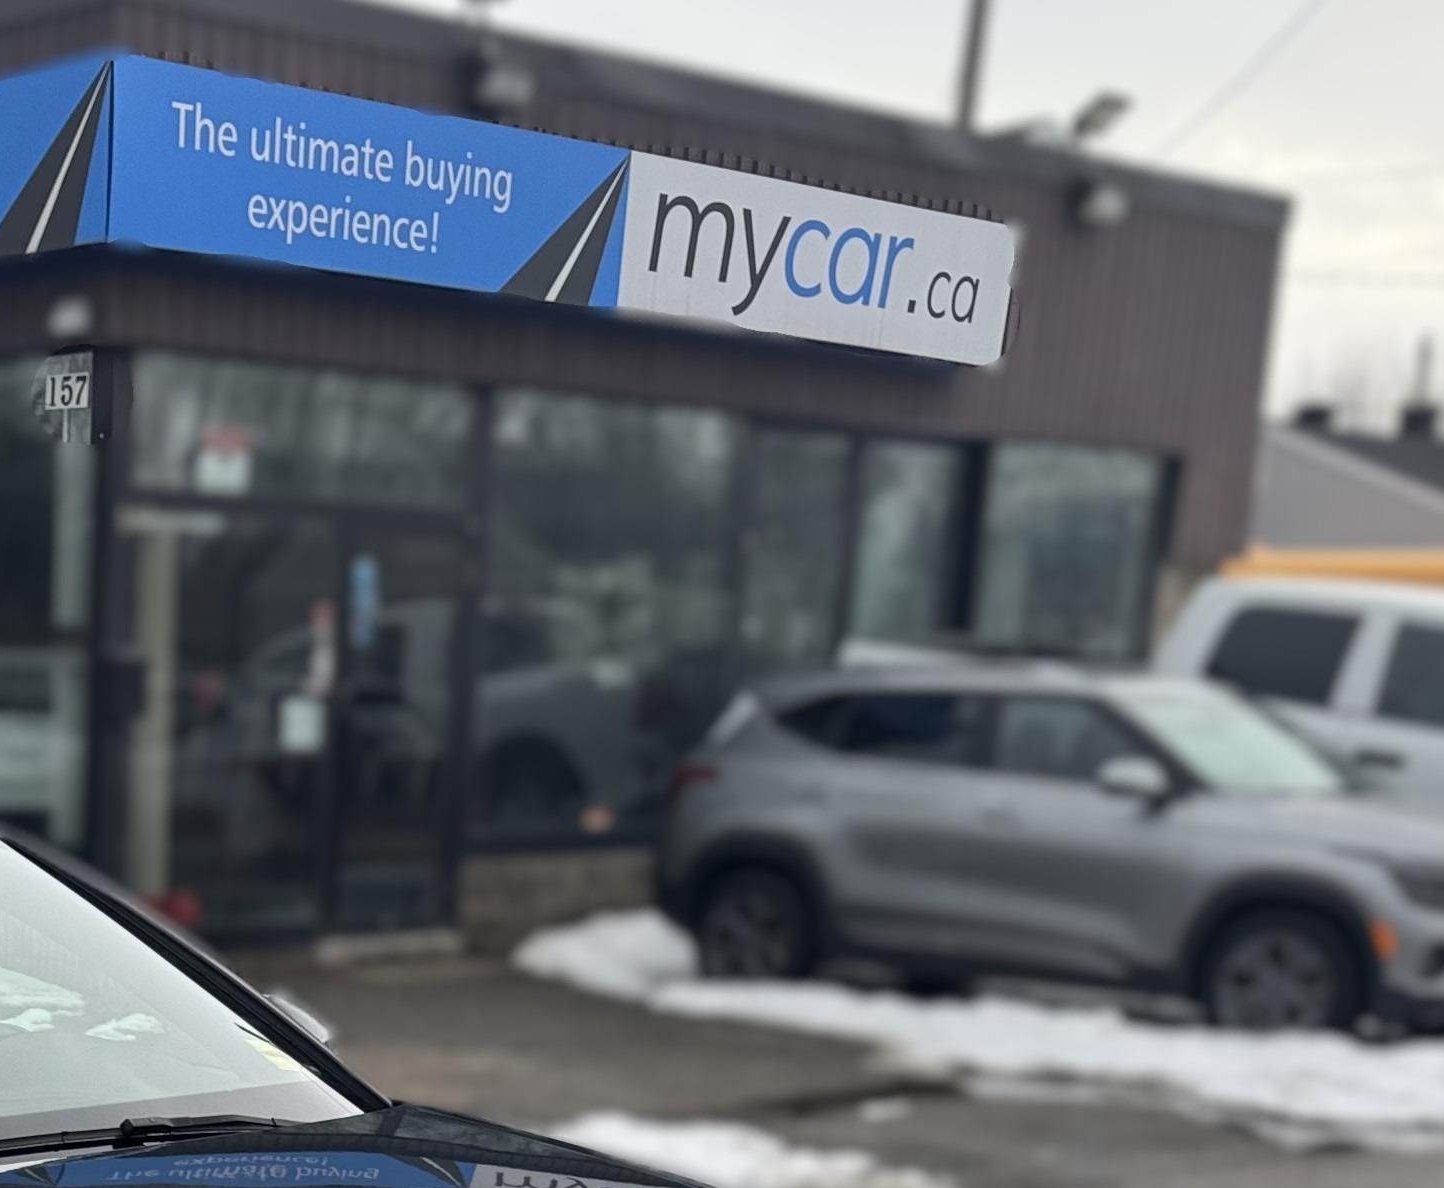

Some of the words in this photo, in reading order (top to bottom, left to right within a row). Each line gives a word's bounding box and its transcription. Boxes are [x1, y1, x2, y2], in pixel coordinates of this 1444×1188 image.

[171, 100, 238, 158] The
[250, 116, 394, 183] ultimate
[404, 139, 513, 214] buying
[247, 193, 440, 254] experience!
[648, 192, 980, 324] mycar.ca
[49, 375, 87, 407] 157
